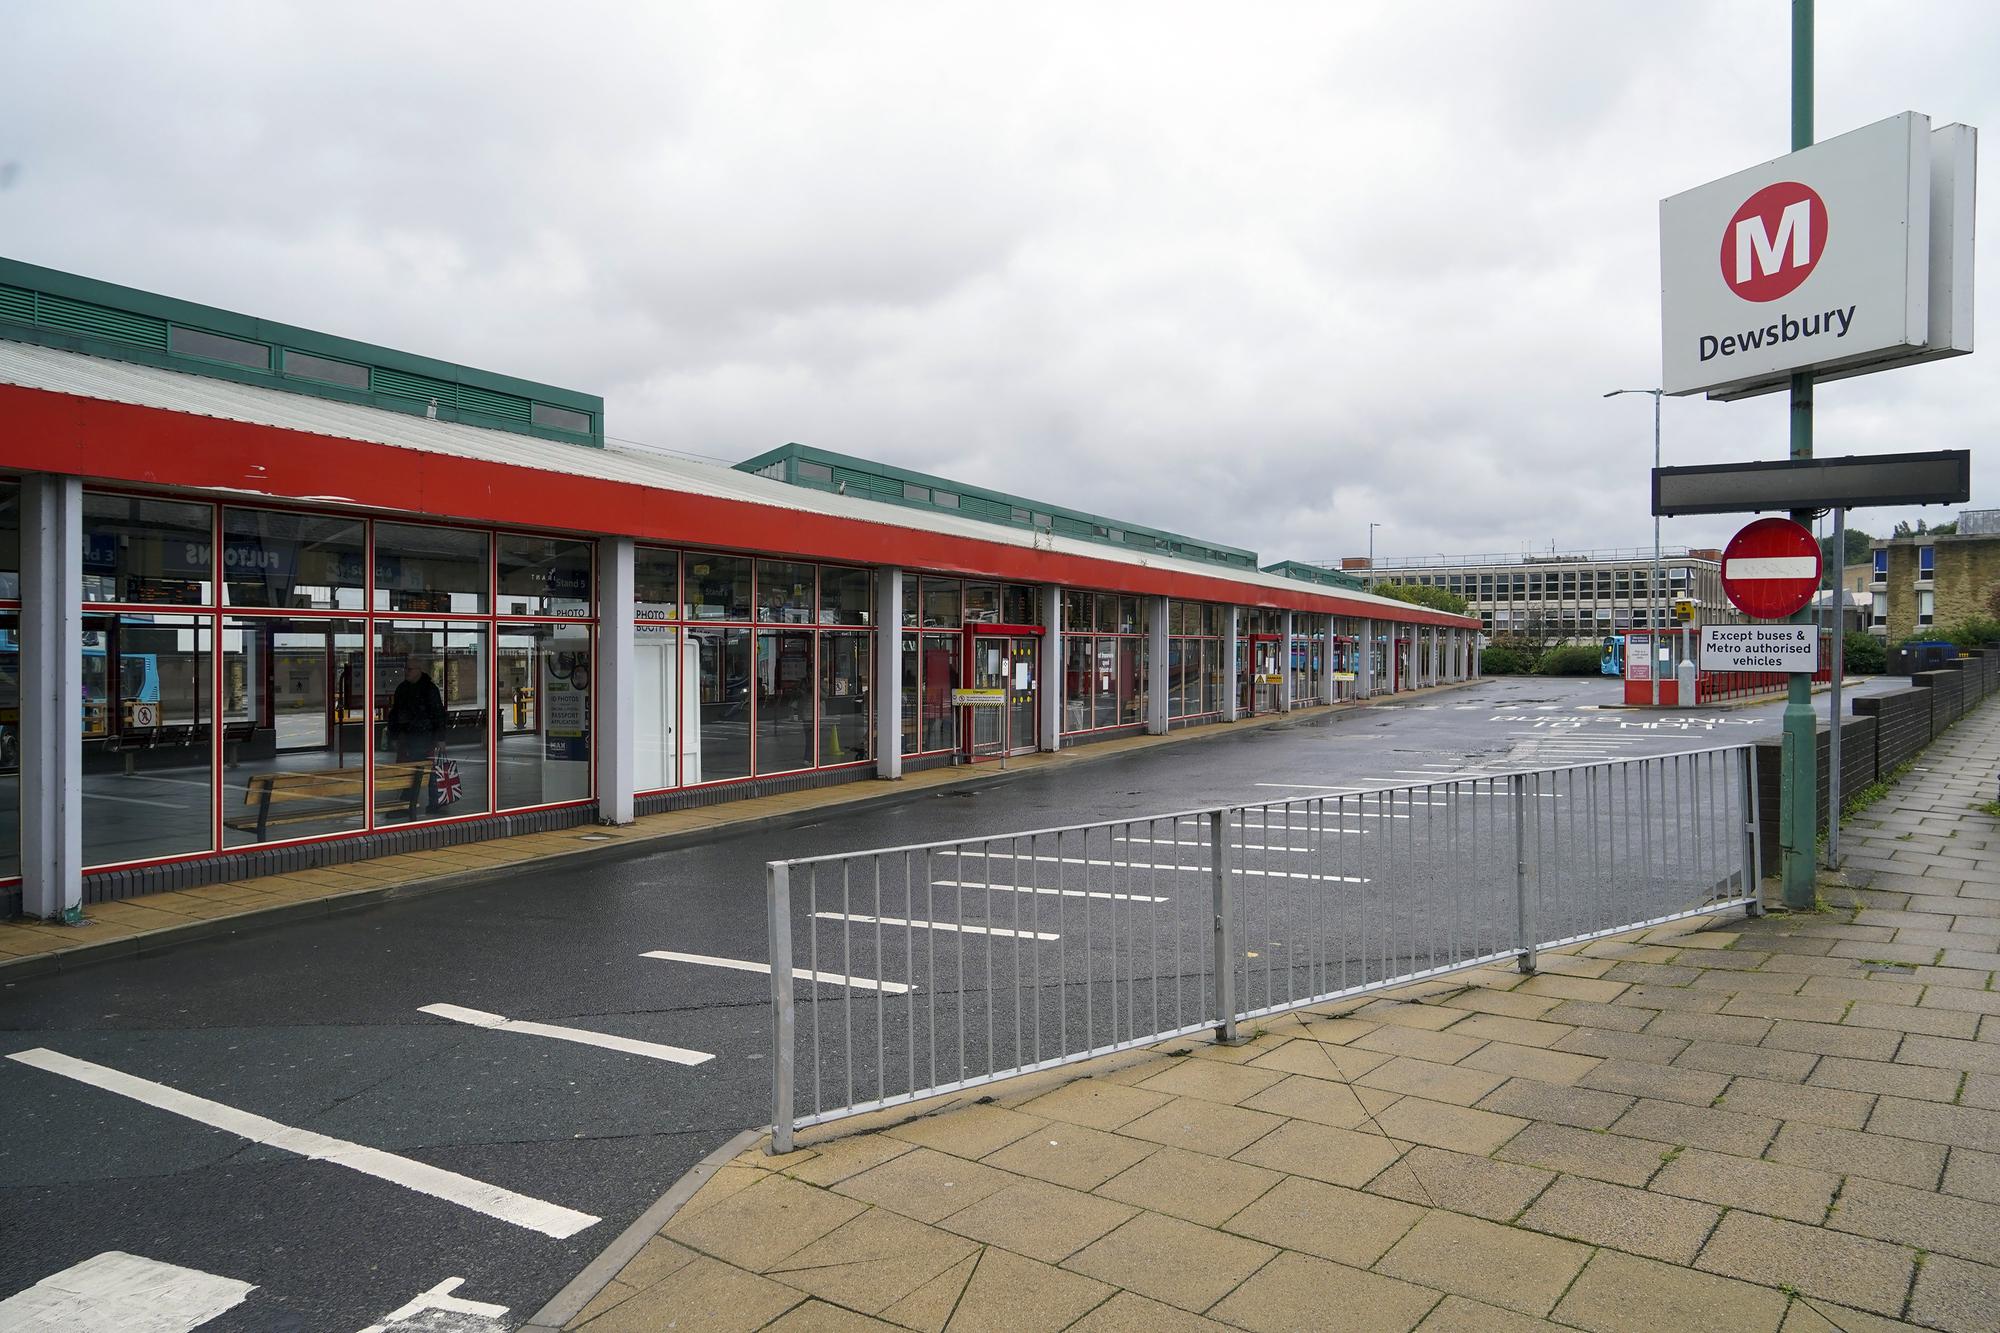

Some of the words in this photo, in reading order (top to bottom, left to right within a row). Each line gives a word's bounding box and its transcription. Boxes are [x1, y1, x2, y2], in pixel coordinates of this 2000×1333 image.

[1736, 198, 1811, 285] M
[1699, 305, 1857, 362] Dewsbury
[556, 609, 585, 618] PHOTO
[636, 609, 665, 620] PHOTO
[1712, 630, 1753, 642] Except
[1757, 630, 1793, 640] buses
[1796, 630, 1805, 640] &
[1706, 643, 1741, 653] Metro
[1745, 643, 1811, 654] authorised
[1732, 655, 1782, 666] vehicles
[1659, 717, 1765, 725] ONLY
